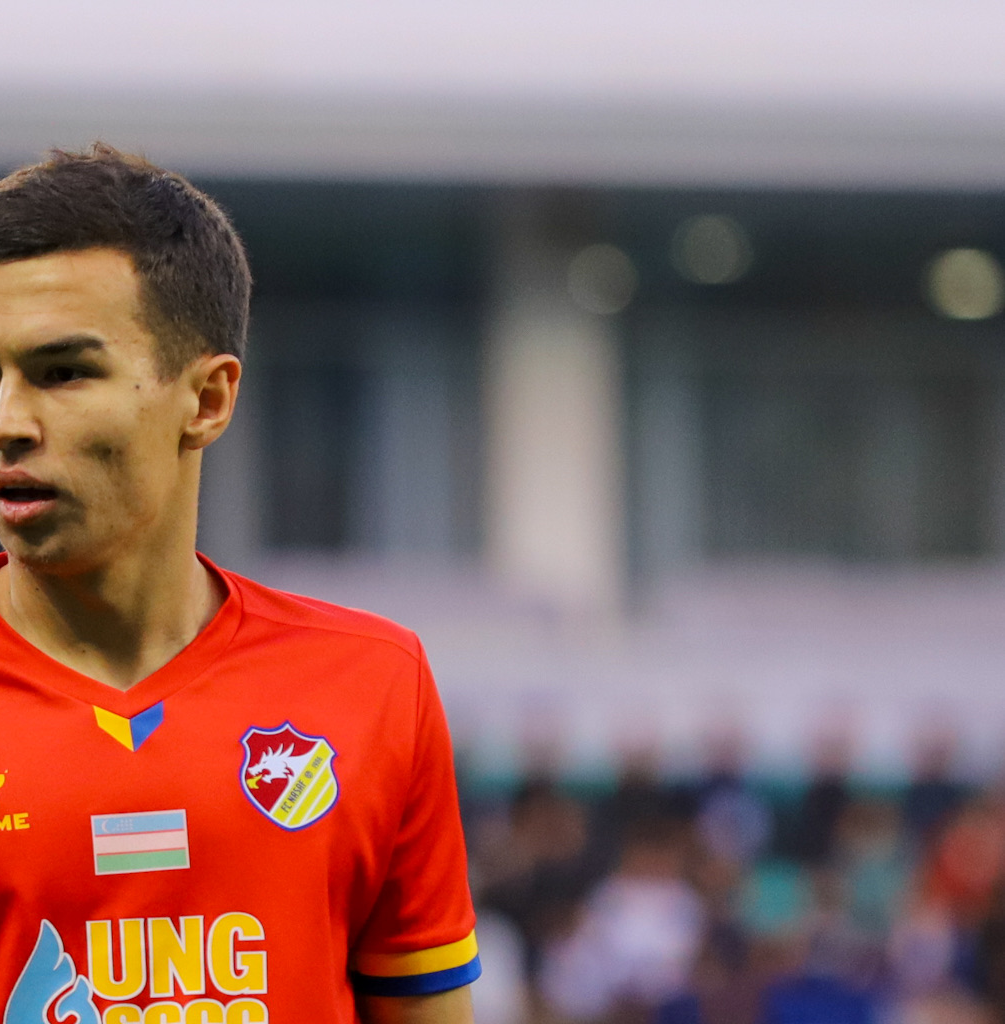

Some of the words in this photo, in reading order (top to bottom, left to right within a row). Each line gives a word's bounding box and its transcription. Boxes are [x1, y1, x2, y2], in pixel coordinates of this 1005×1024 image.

[280, 801, 293, 814] FC
[287, 778, 307, 804] NASAF
[86, 911, 268, 1001] UNG
